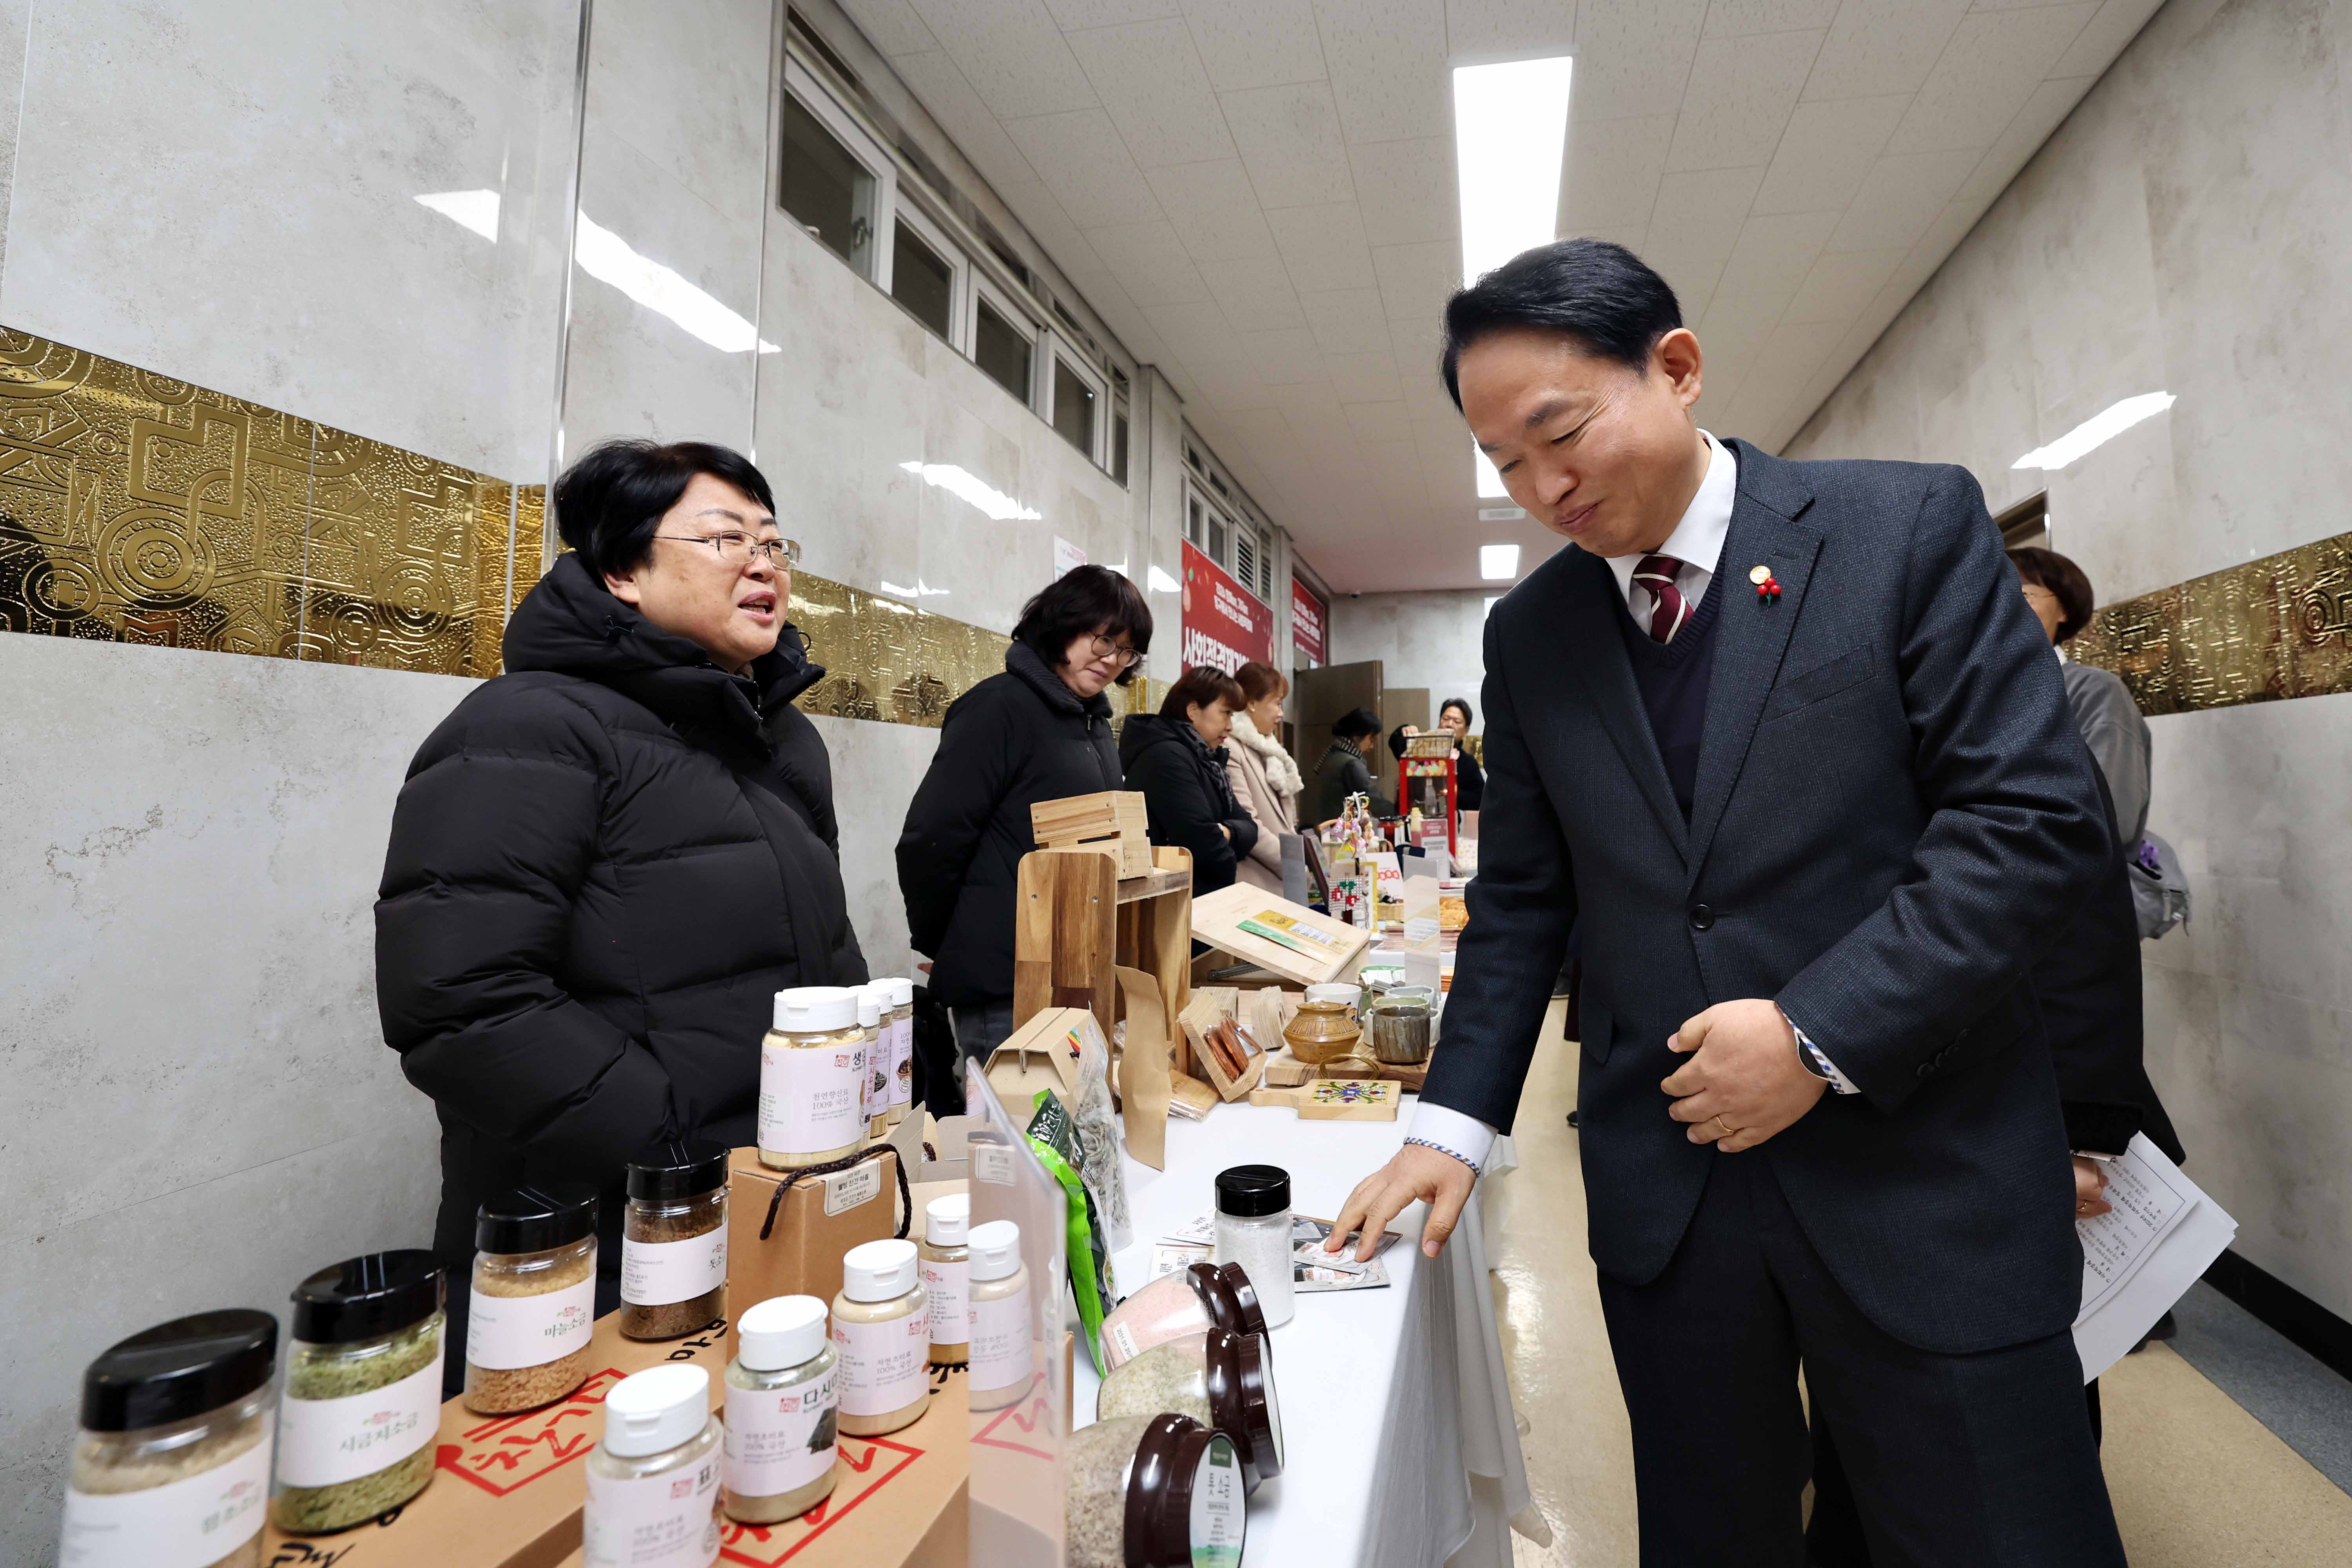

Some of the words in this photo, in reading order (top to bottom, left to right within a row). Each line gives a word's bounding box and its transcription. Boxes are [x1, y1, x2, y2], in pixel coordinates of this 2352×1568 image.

[813, 1089, 848, 1101] 천연향신료
[812, 1101, 834, 1111] 100%
[836, 1097, 849, 1107] 국산
[2120, 1196, 2141, 1216] 사회적경제
[544, 1312, 586, 1338] 마늘소금
